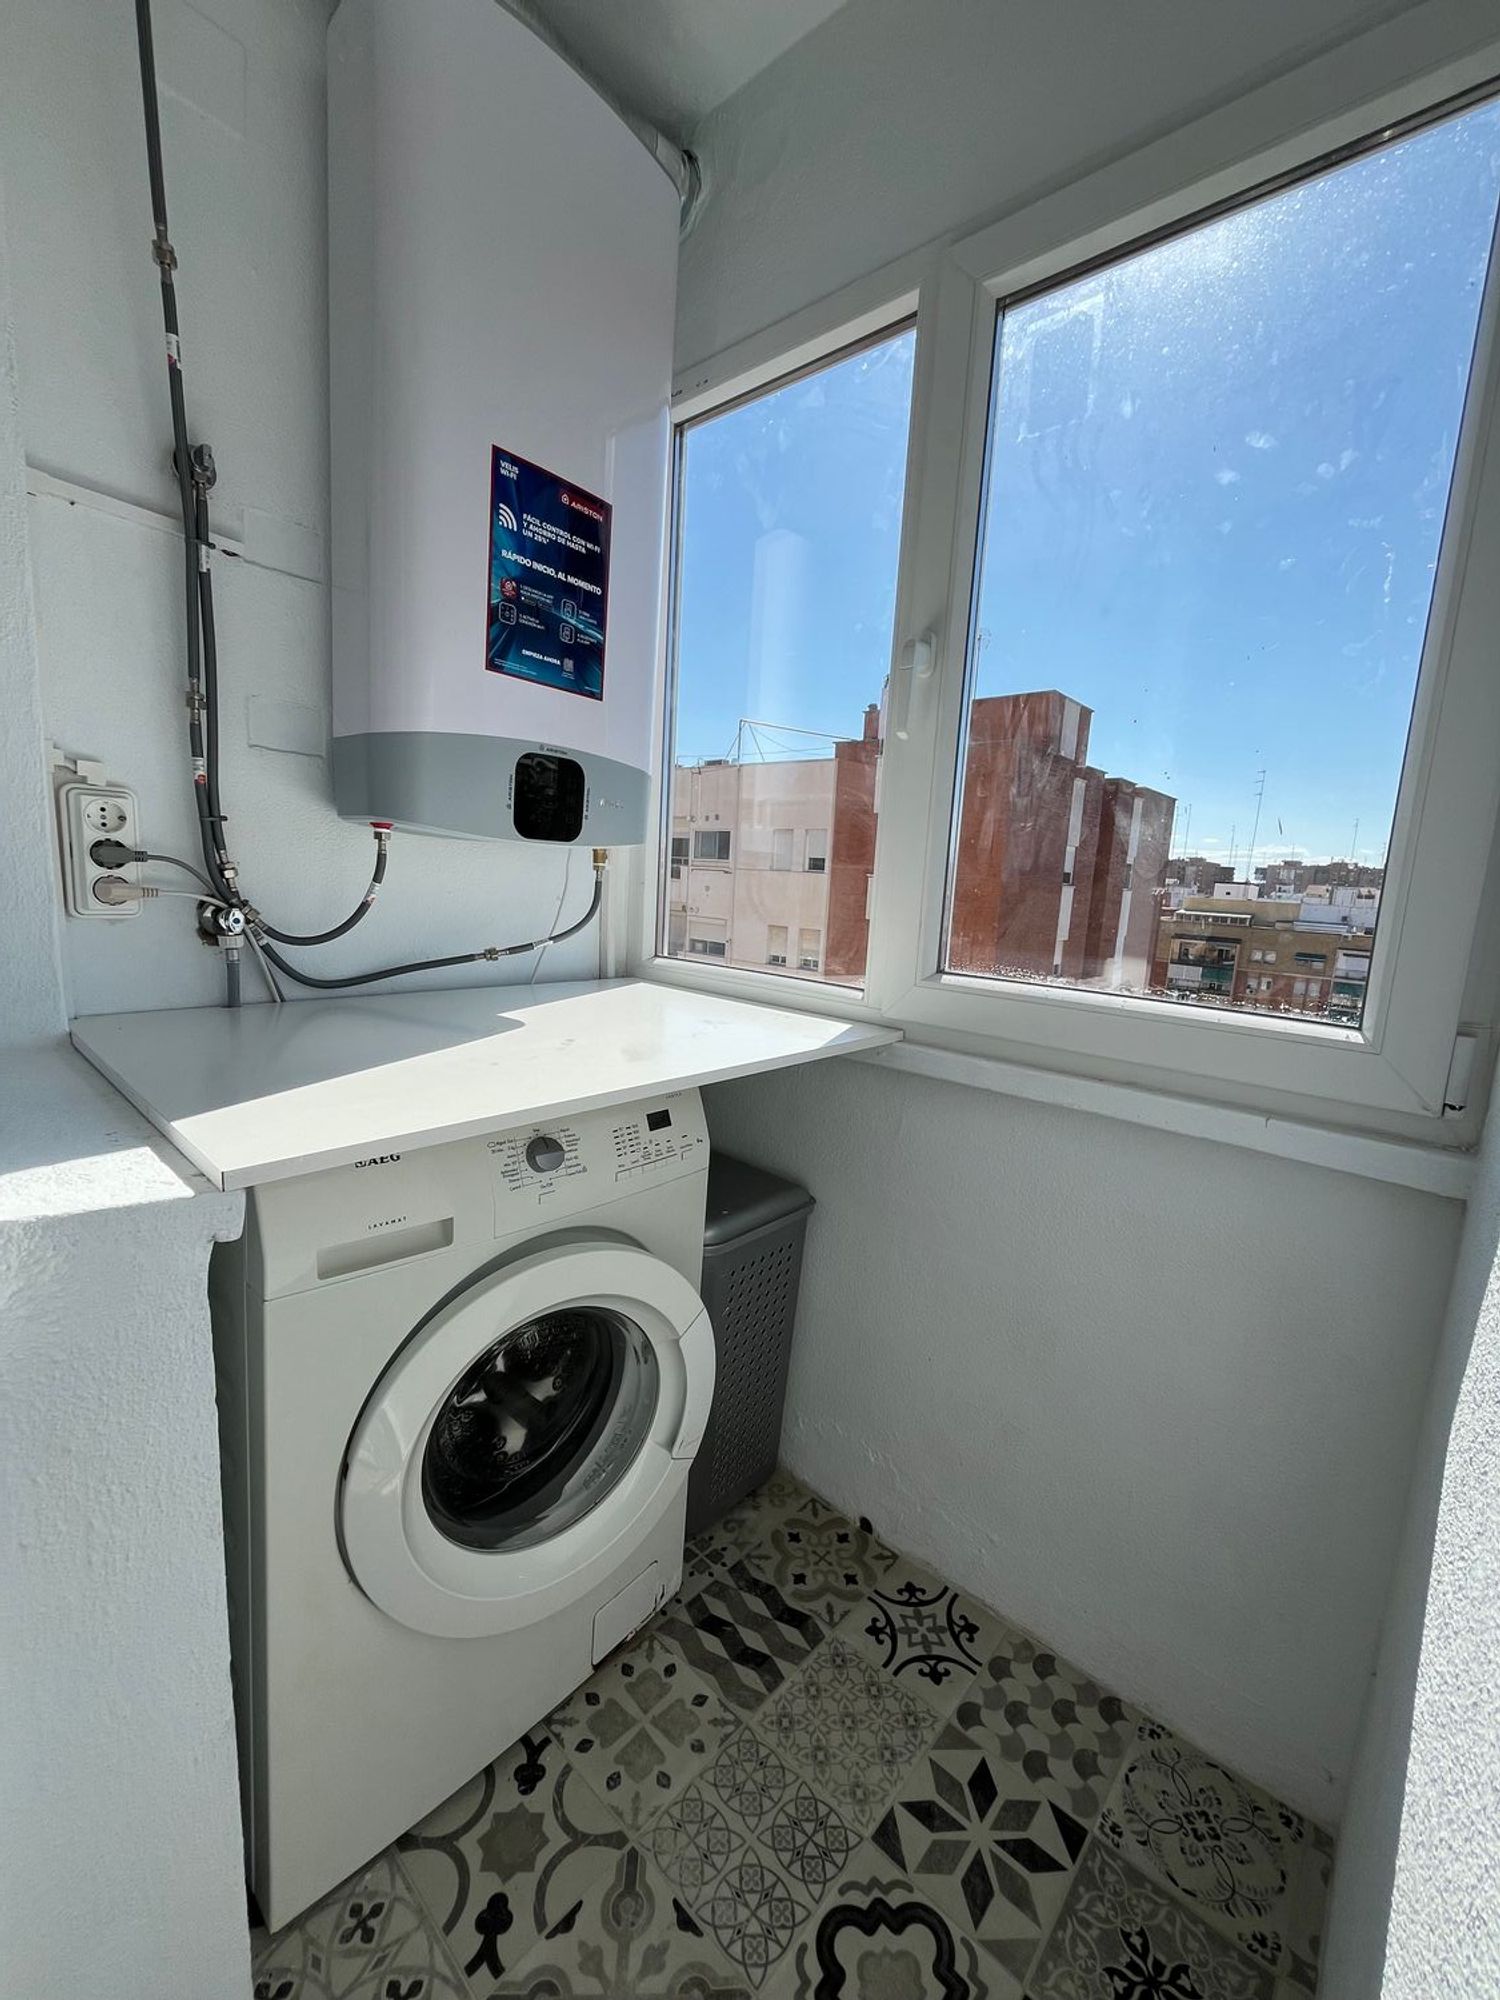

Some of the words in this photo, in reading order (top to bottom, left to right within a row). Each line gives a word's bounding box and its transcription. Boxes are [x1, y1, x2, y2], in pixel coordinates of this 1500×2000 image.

[499, 467, 517, 480] WI-FI
[500, 460, 519, 475] VELIS
[571, 501, 603, 522] ARISTON
[522, 513, 541, 527] FÁCIL
[542, 522, 572, 540] CONTROL
[572, 535, 586, 547] CON
[586, 541, 601, 554] WI-FI
[522, 529, 534, 538] UN
[528, 523, 556, 540] AHORRO
[557, 536, 566, 545] DE
[566, 540, 587, 554] HASTA
[501, 549, 532, 567] RÁPIDO
[532, 560, 558, 578] INICIO,
[557, 572, 567, 582] AL
[567, 575, 602, 596] MOMENTO
[367, 1153, 401, 1166] AEG
